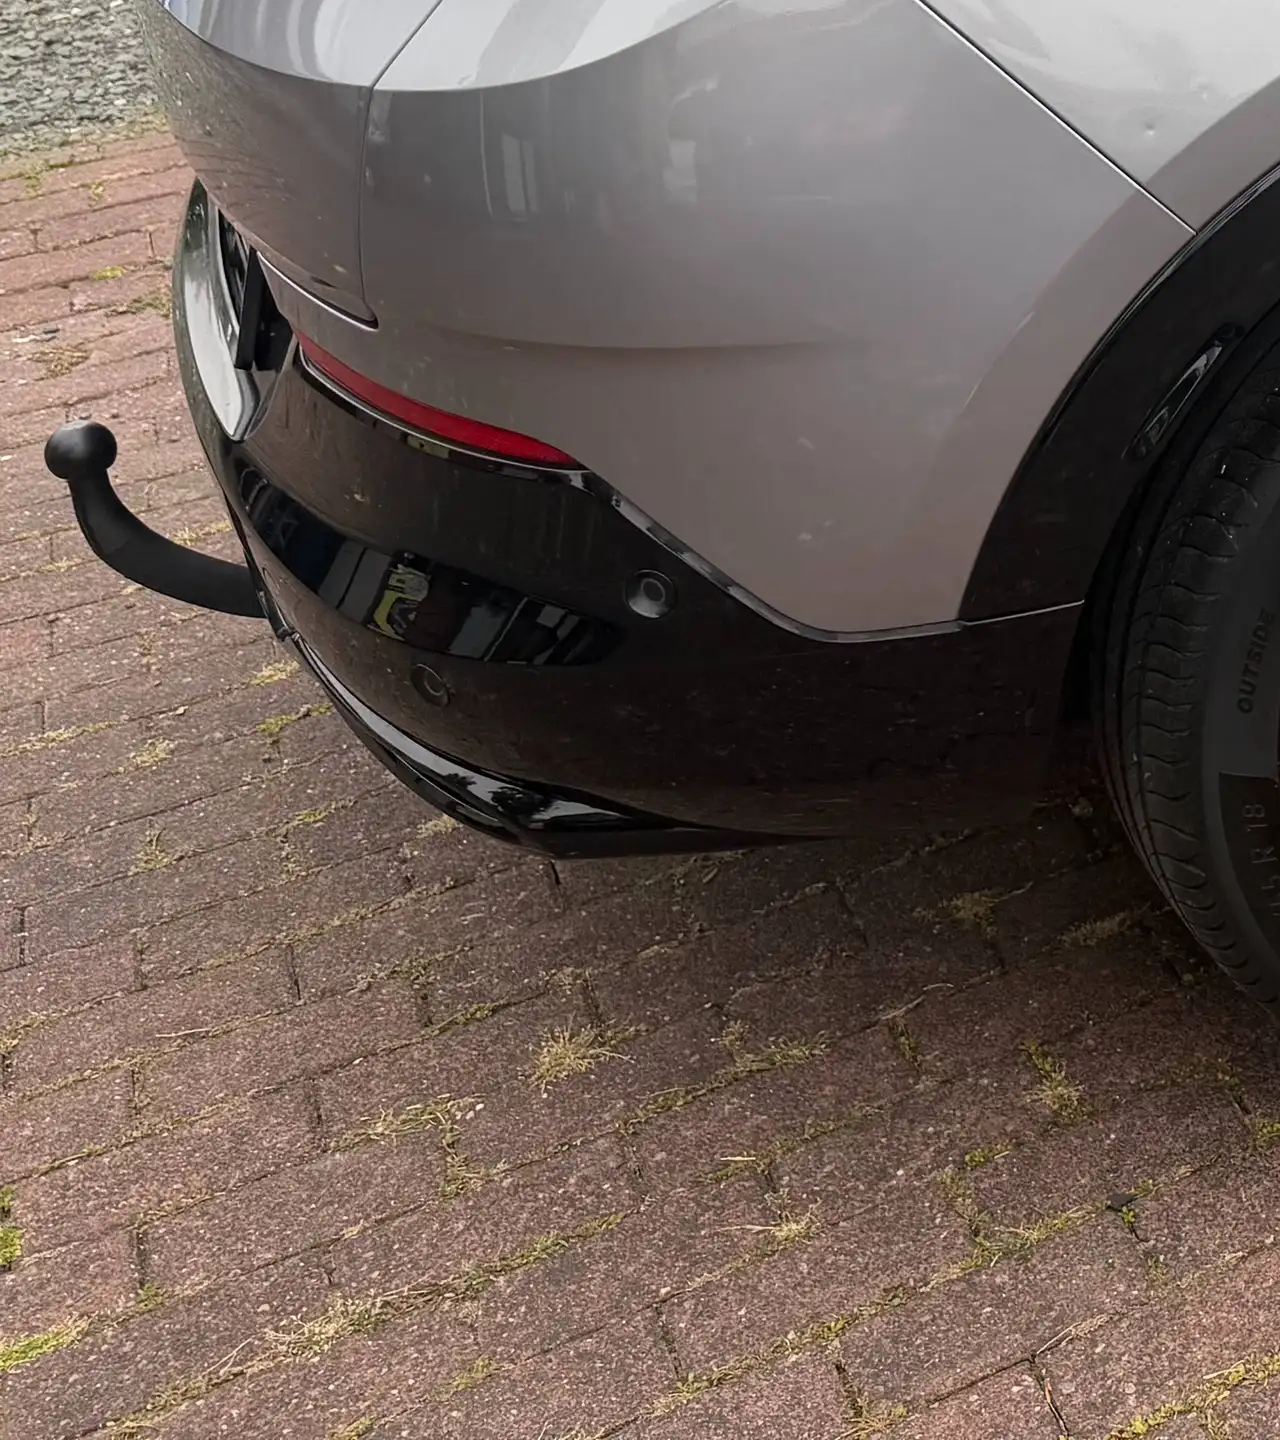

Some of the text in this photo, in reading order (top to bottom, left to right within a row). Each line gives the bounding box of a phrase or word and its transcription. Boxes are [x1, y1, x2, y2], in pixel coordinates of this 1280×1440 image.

[1236, 605, 1277, 715] OUTSIDE
[1242, 802, 1270, 834] 18
[1249, 844, 1280, 866] R
